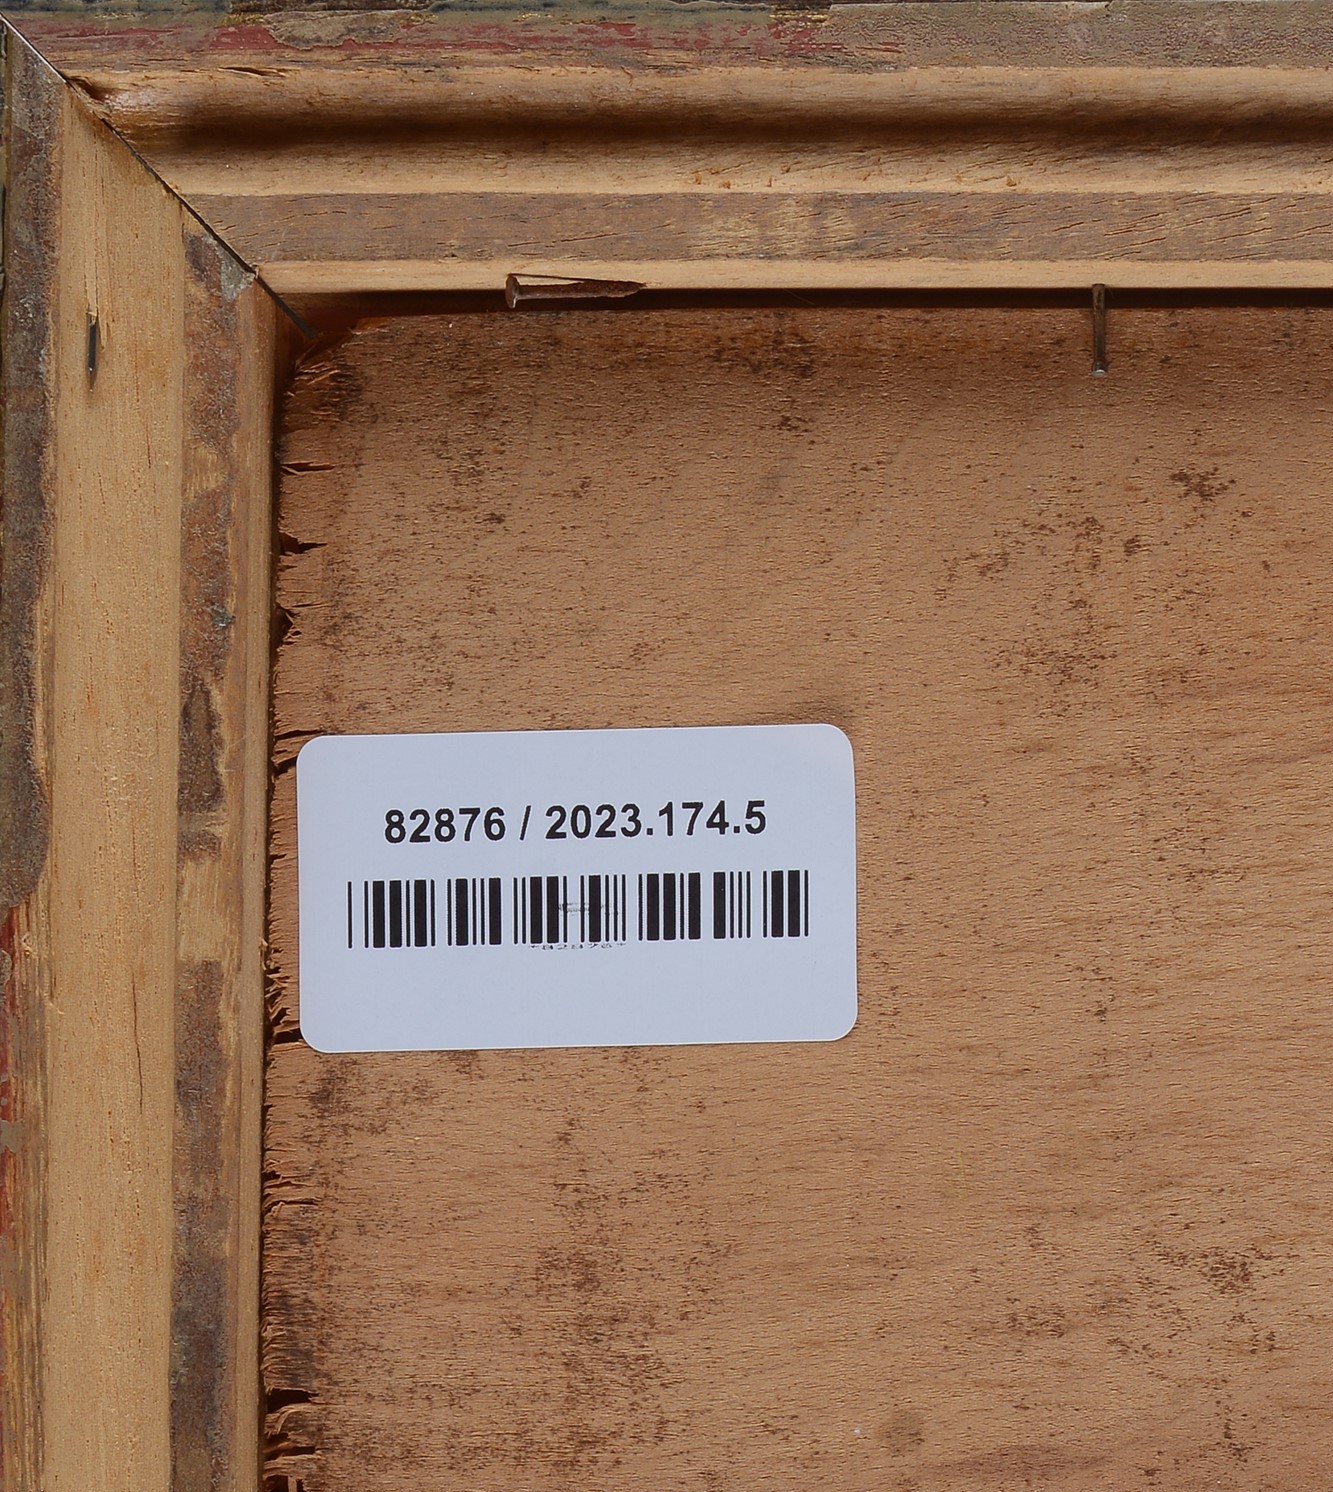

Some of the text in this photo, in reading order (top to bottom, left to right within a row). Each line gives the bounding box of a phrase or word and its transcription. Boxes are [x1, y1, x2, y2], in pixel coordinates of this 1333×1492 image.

[384, 799, 766, 844] 82876 / 2023.174.5
